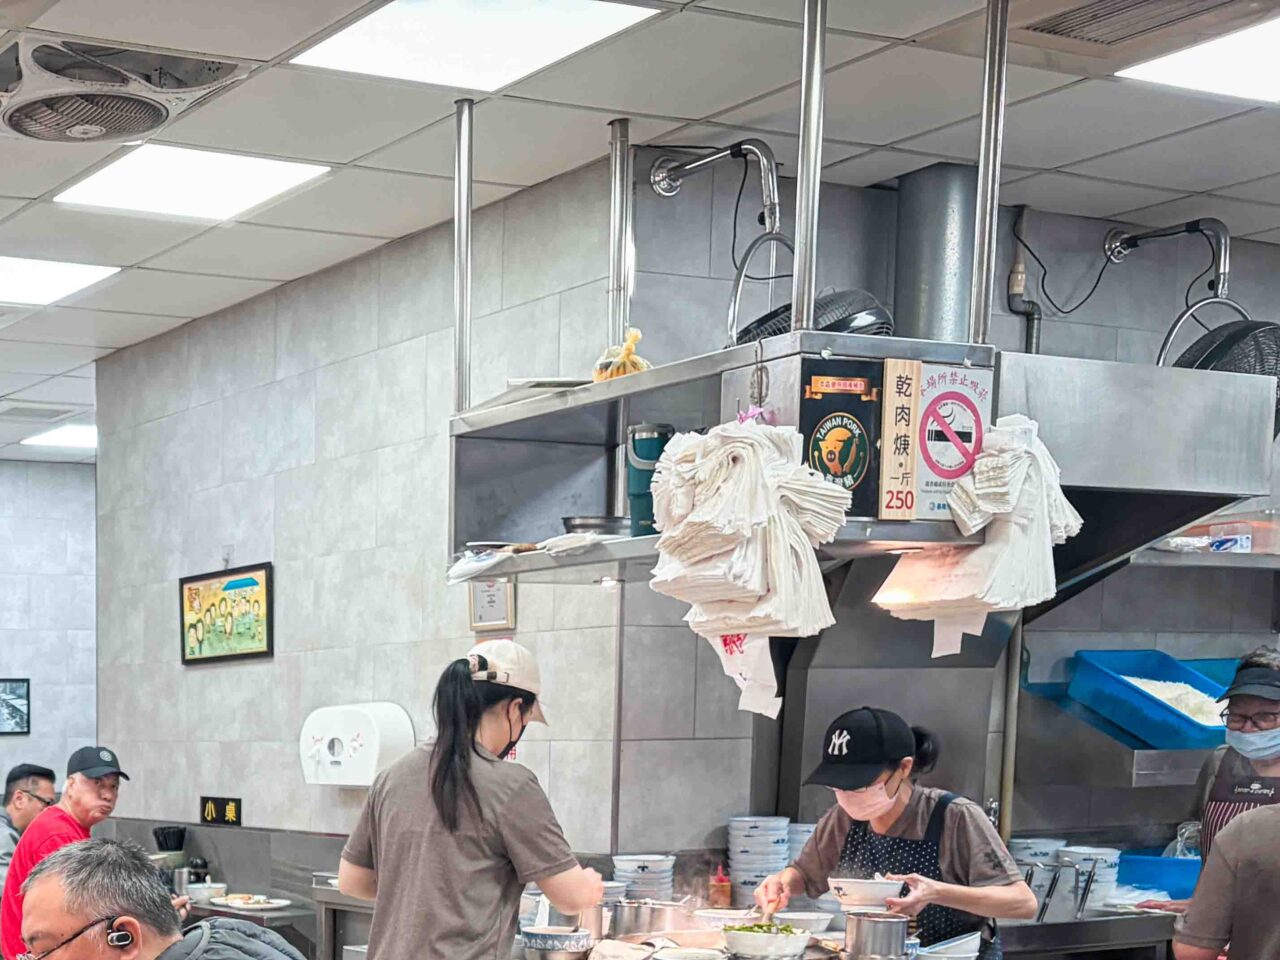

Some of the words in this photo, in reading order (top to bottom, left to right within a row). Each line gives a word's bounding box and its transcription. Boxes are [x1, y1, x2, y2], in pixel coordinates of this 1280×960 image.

[816, 416, 841, 440] TAIWAN
[843, 417, 861, 437] PORK
[885, 490, 914, 510] 250
